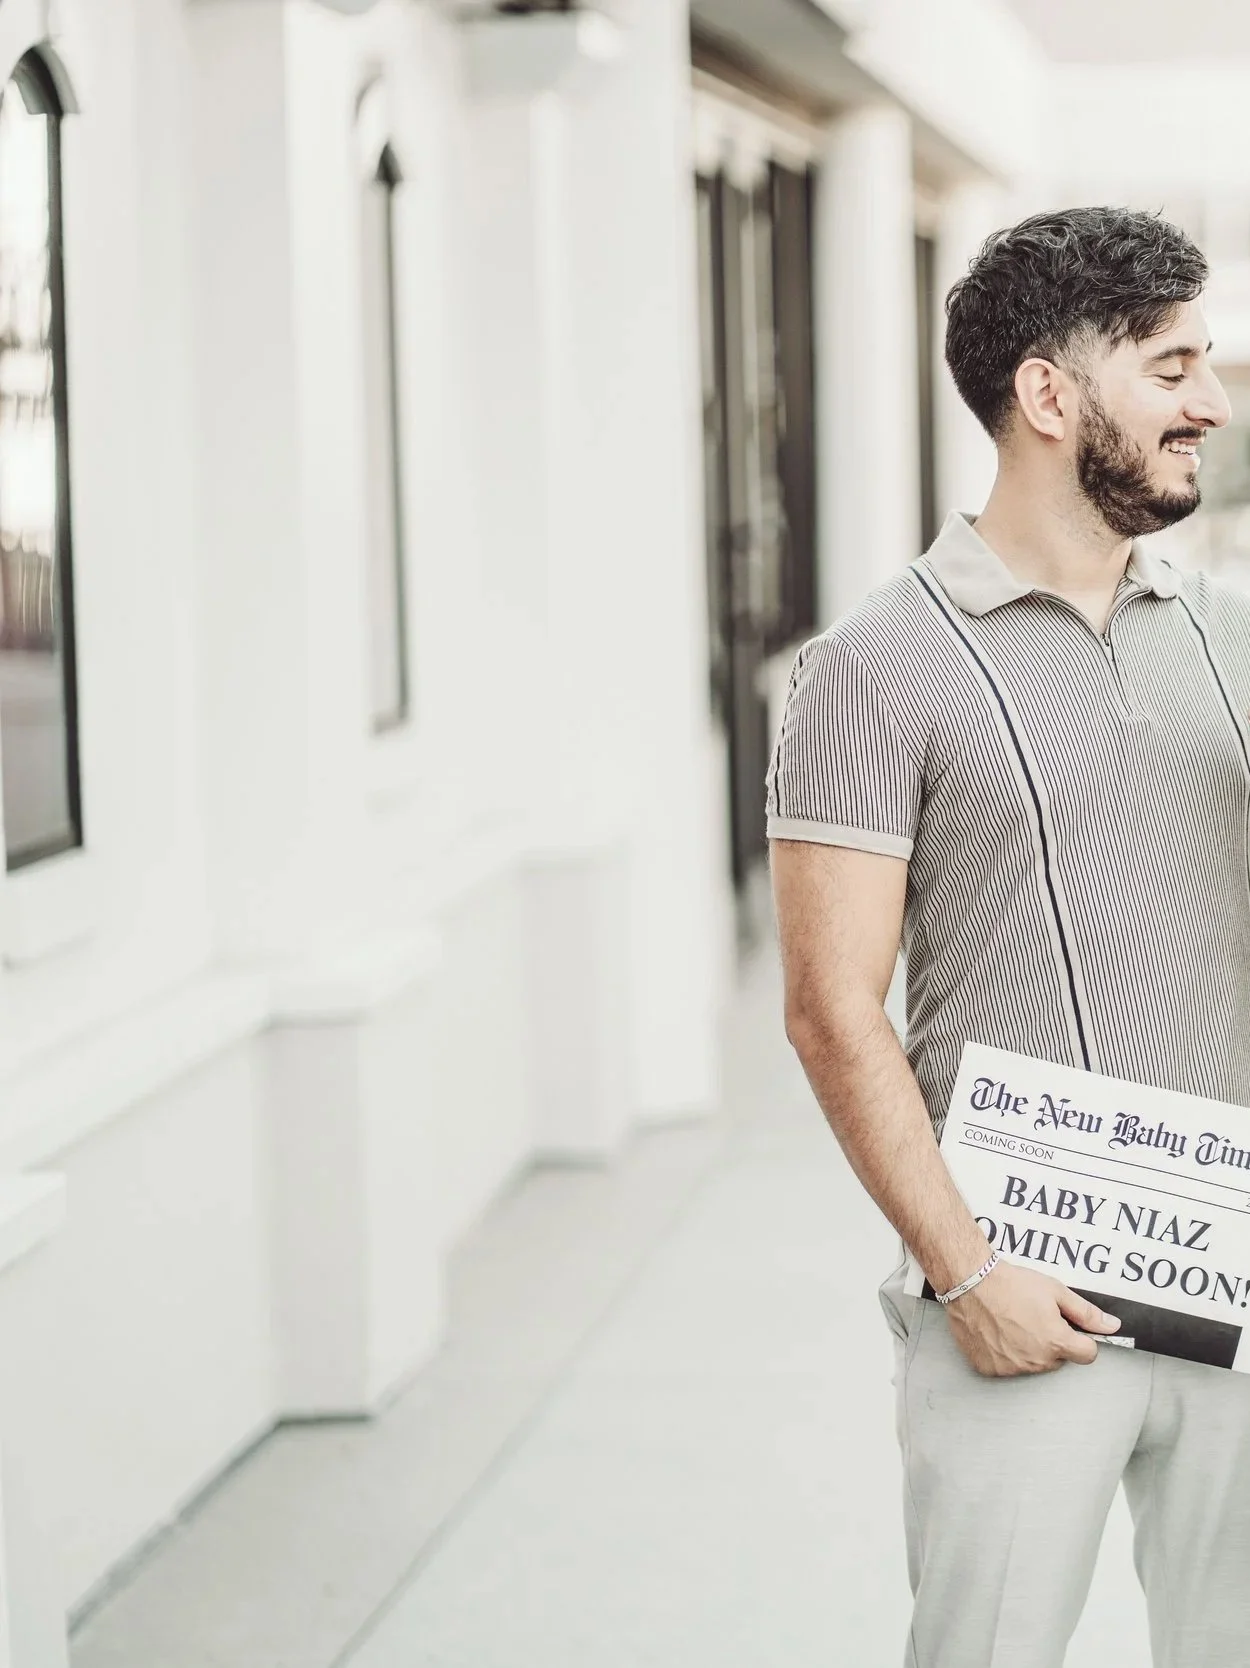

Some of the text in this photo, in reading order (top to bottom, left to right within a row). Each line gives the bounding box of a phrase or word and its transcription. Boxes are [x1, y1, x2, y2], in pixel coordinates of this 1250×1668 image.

[964, 1128, 1054, 1160] COMING SOON
[970, 1077, 1029, 1117] The
[1034, 1093, 1103, 1133] New
[1108, 1112, 1188, 1159] Baby
[974, 1216, 1113, 1274] OMING
[999, 1175, 1213, 1252] BABY NIAZ
